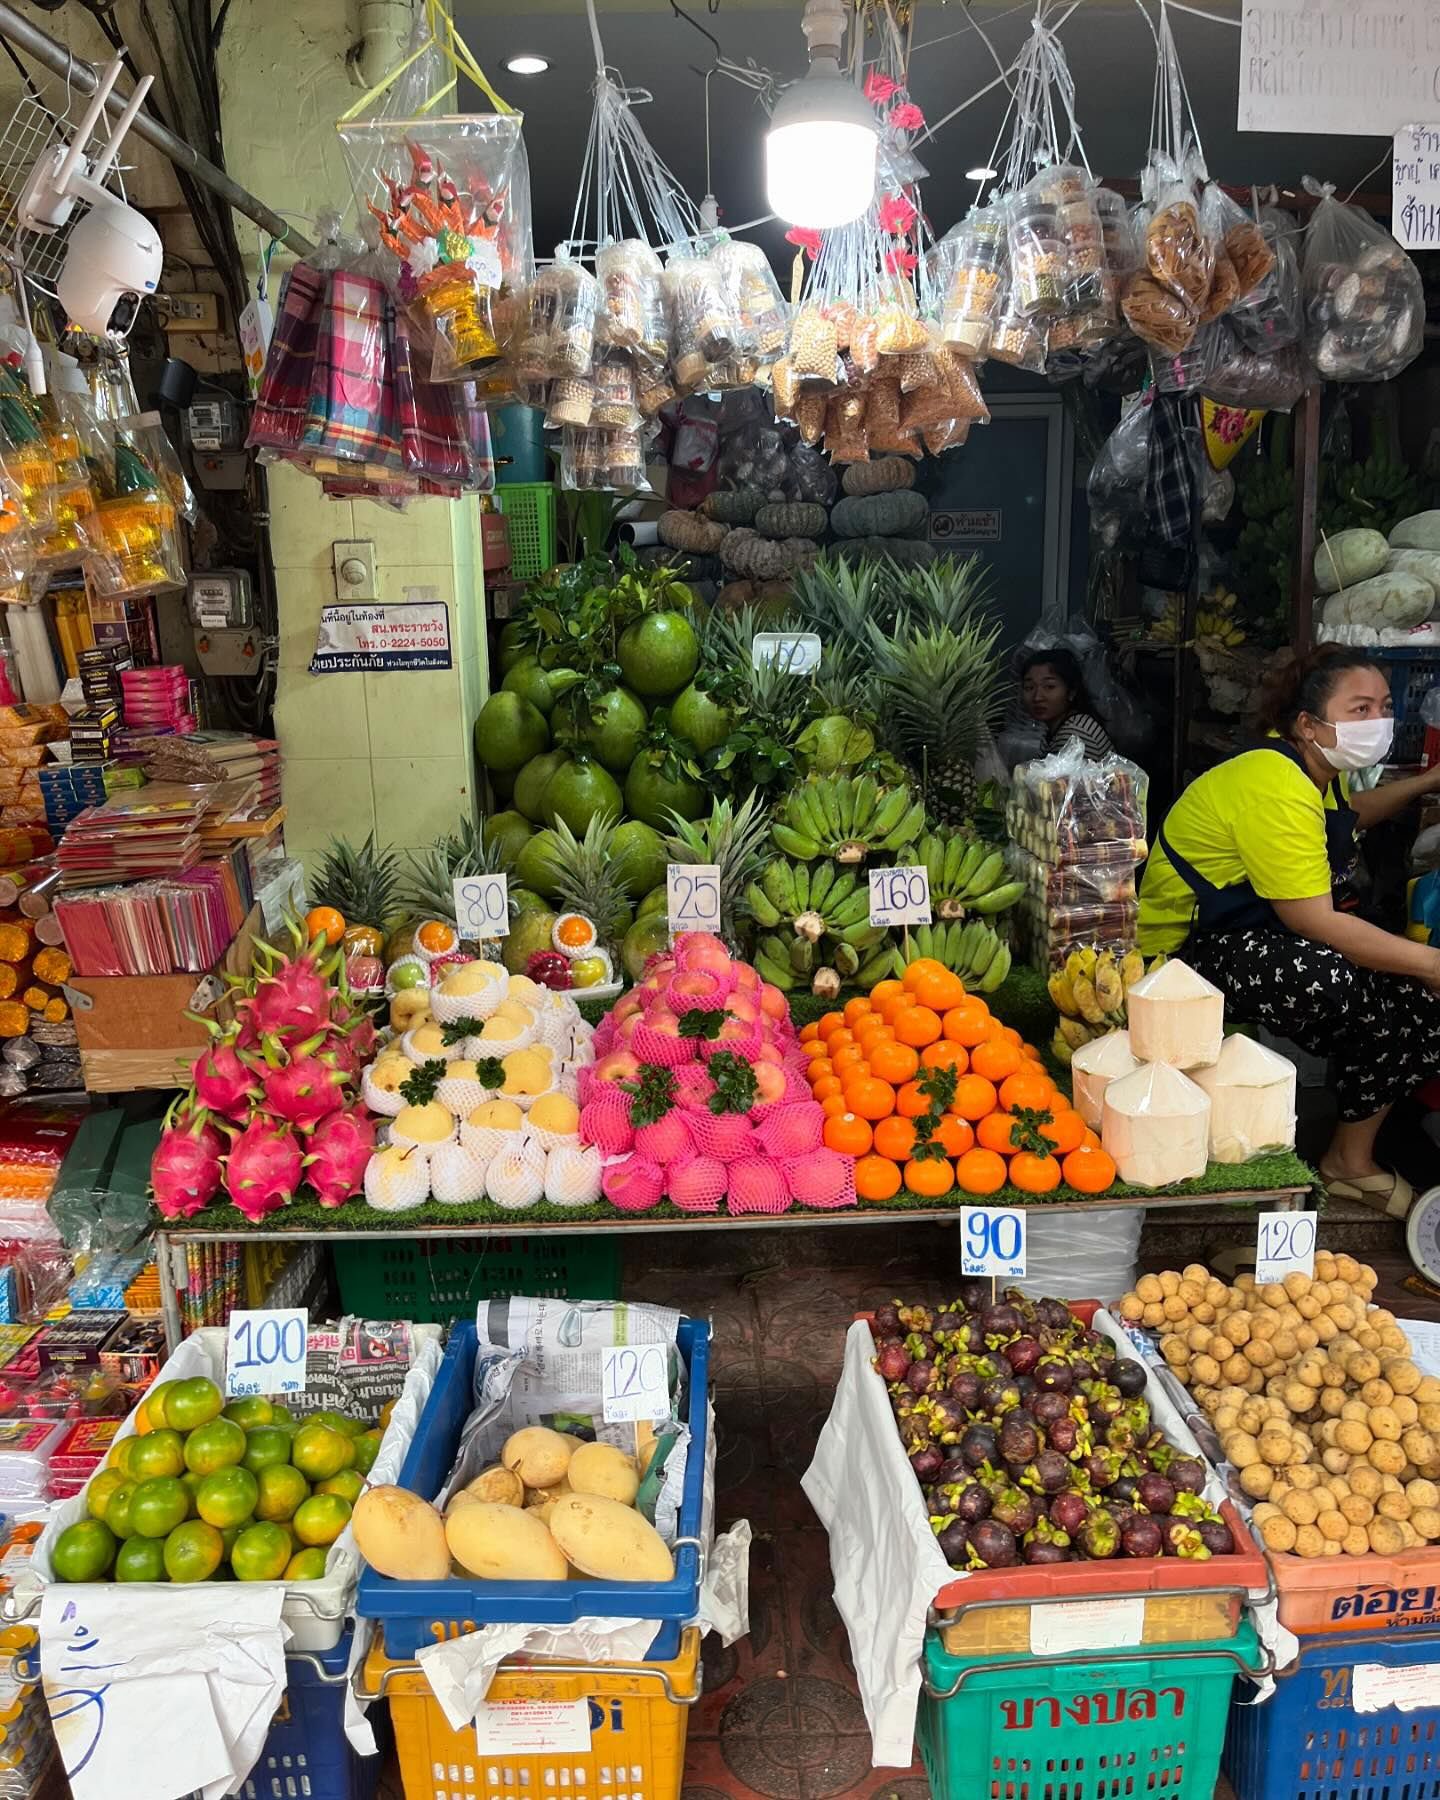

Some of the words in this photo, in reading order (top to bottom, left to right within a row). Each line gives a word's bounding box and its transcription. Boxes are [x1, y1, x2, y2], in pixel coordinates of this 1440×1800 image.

[1401, 194, 1440, 242] ต้น
[371, 620, 444, 635] สน.พระราชวัง
[380, 637, 446, 649] 0-2224-5050
[462, 882, 504, 927] 80
[674, 875, 718, 919] 25
[874, 874, 926, 912] 160
[966, 1211, 1022, 1261] 90
[1259, 1218, 1315, 1262] 120
[233, 1317, 306, 1368] 100
[604, 1348, 665, 1399] 120
[1000, 1687, 1186, 1730] บางปลา
